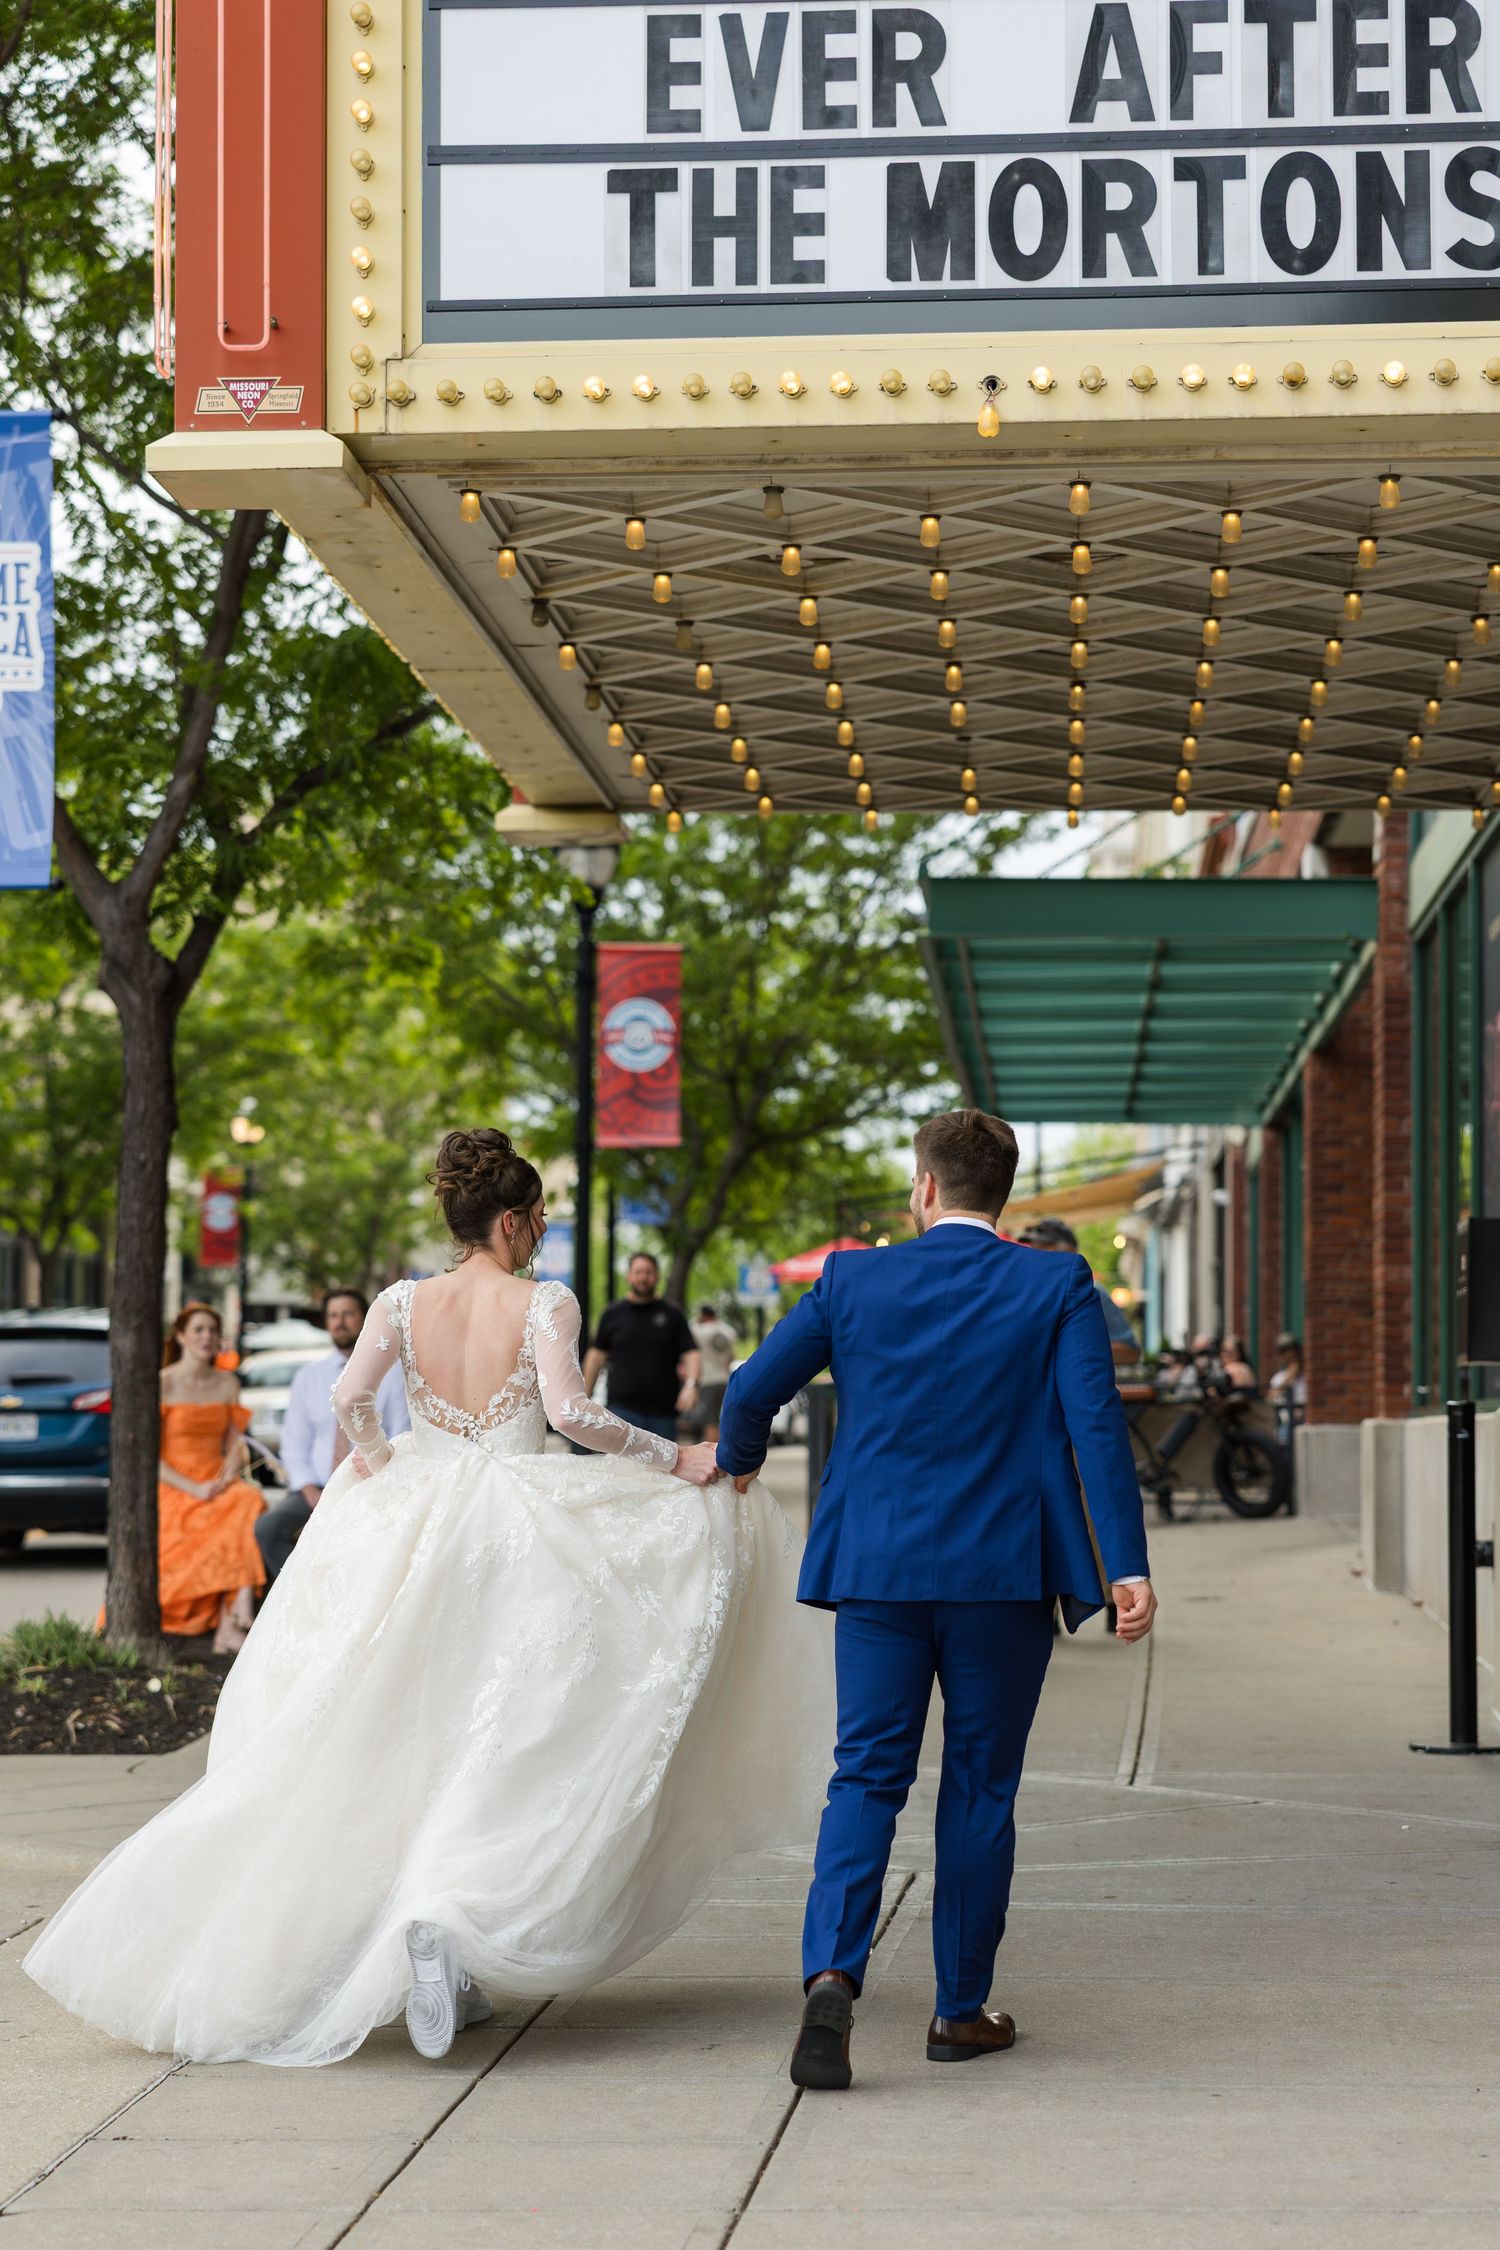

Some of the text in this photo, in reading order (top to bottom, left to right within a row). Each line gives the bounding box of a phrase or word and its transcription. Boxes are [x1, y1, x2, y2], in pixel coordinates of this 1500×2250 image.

[647, 0, 1483, 134] EVER AFTER
[607, 146, 1500, 288] THE MORTONS
[229, 382, 269, 391] MISSOURI
[237, 391, 260, 400] NEON
[242, 400, 256, 409] CO.
